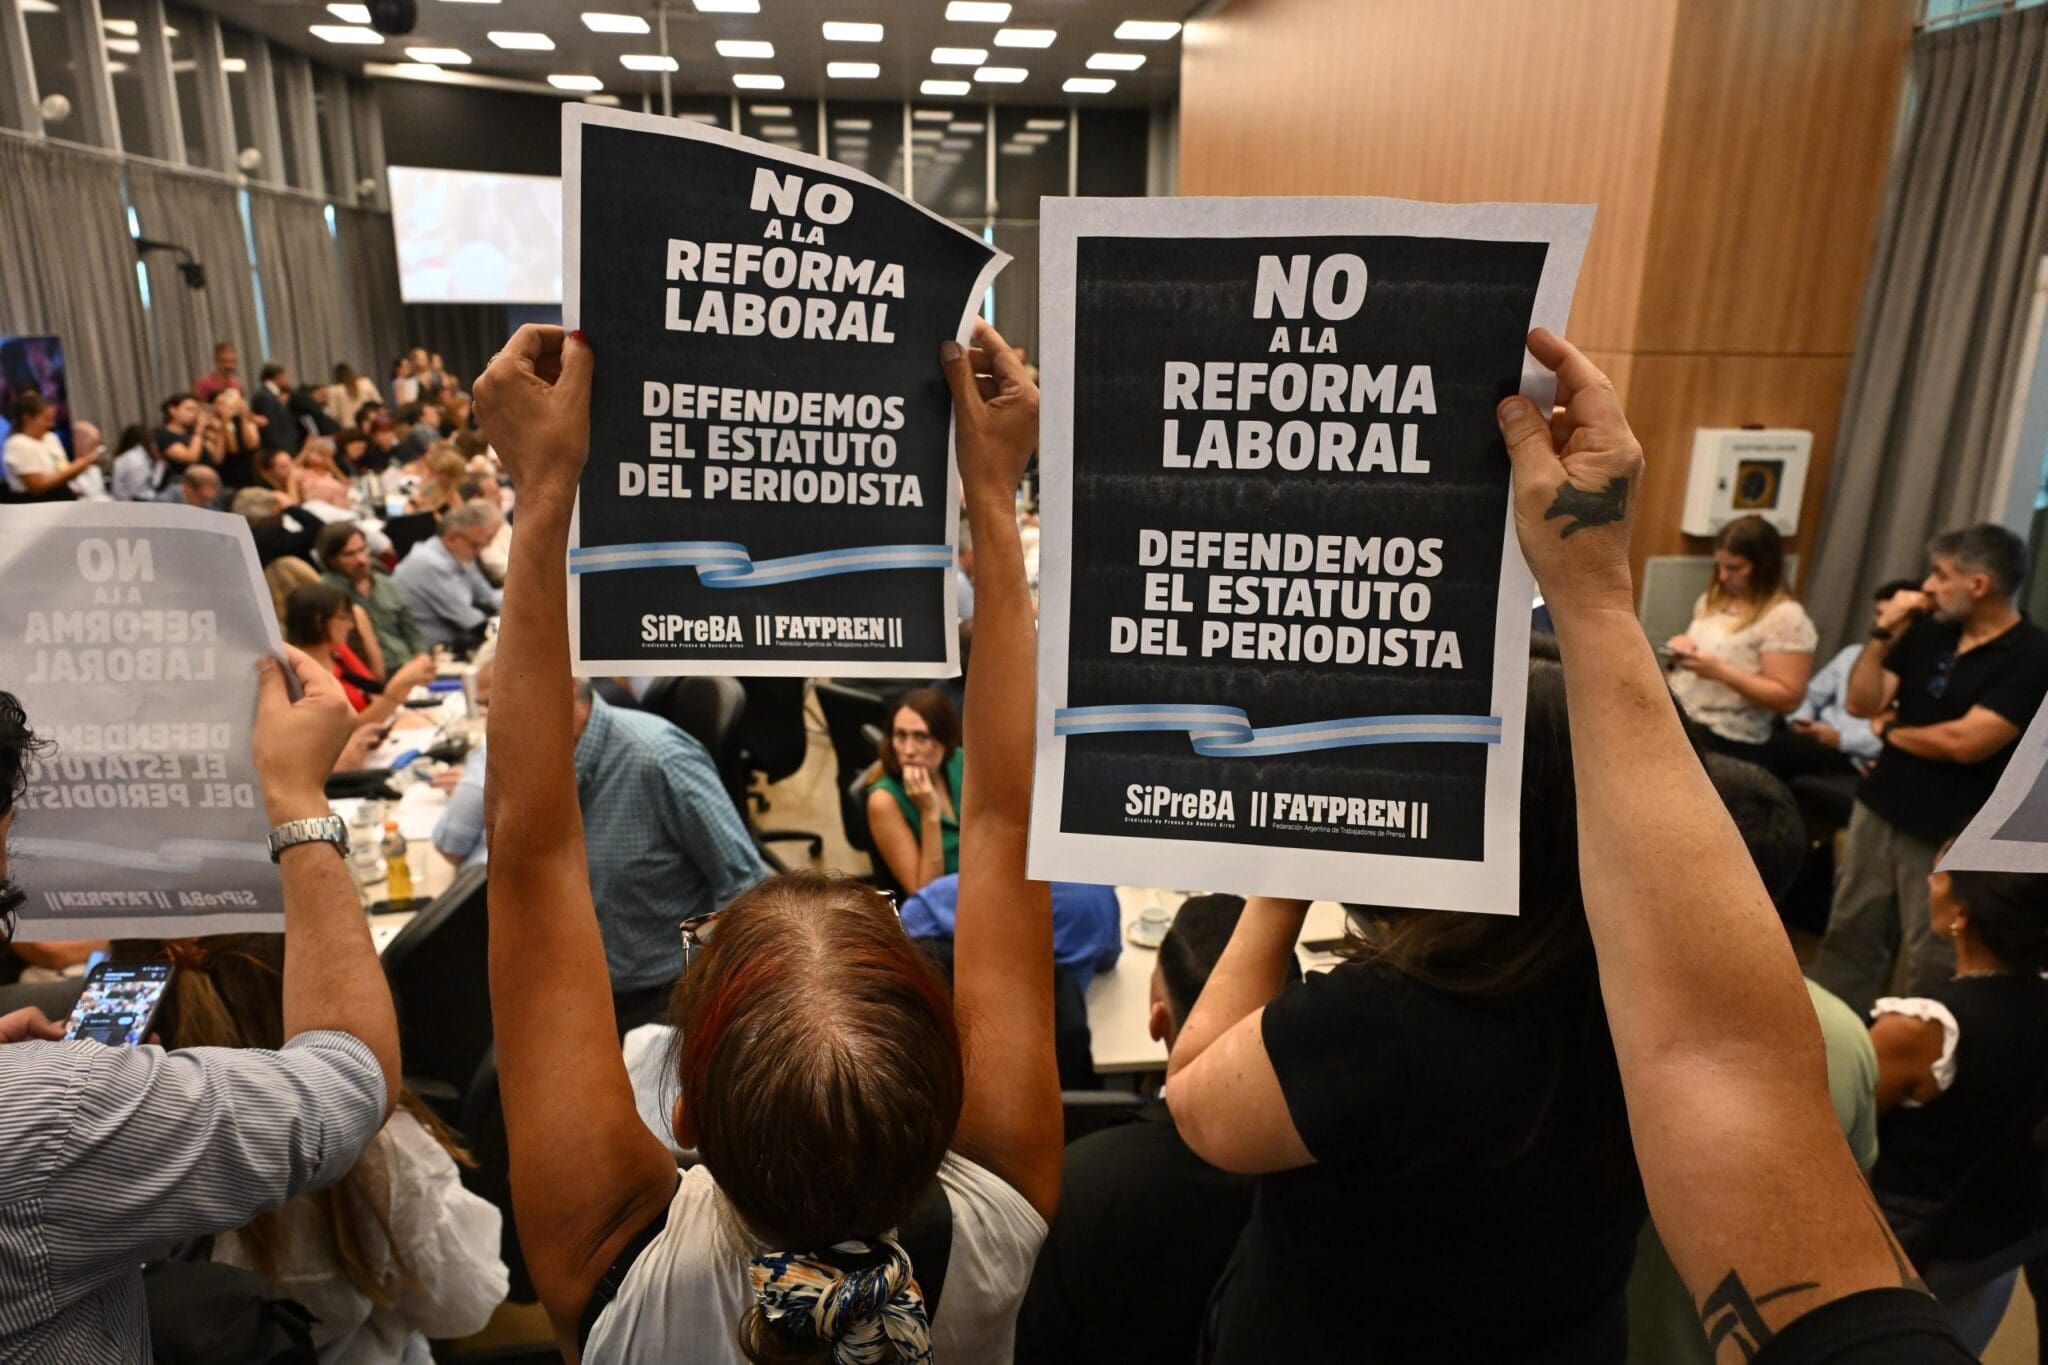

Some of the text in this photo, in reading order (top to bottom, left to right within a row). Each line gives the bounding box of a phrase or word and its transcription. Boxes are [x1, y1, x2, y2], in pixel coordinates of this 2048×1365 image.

[750, 168, 853, 224] NO
[764, 219, 824, 245] A LA
[666, 239, 904, 298] REFORMA
[1253, 254, 1367, 320] NO
[666, 288, 894, 343] LABORAL
[1269, 327, 1337, 353] A LA
[644, 381, 904, 430] DEFENDEMOS
[1164, 362, 1436, 414] REFORMA
[651, 423, 896, 467] EL ESTATUTO
[1163, 420, 1430, 473] LABORAL
[620, 463, 923, 506] DEL PERIODISTA
[1139, 529, 1443, 577] DEFENDEMOS
[1145, 573, 1431, 621] EL ESTATUTO
[642, 615, 884, 641] SiPreBA FATPREN
[1111, 617, 1462, 668] DEL PERIODISTA
[1126, 784, 1406, 828] SiPreBA FATPREN
[1304, 825, 1331, 834] Argentina
